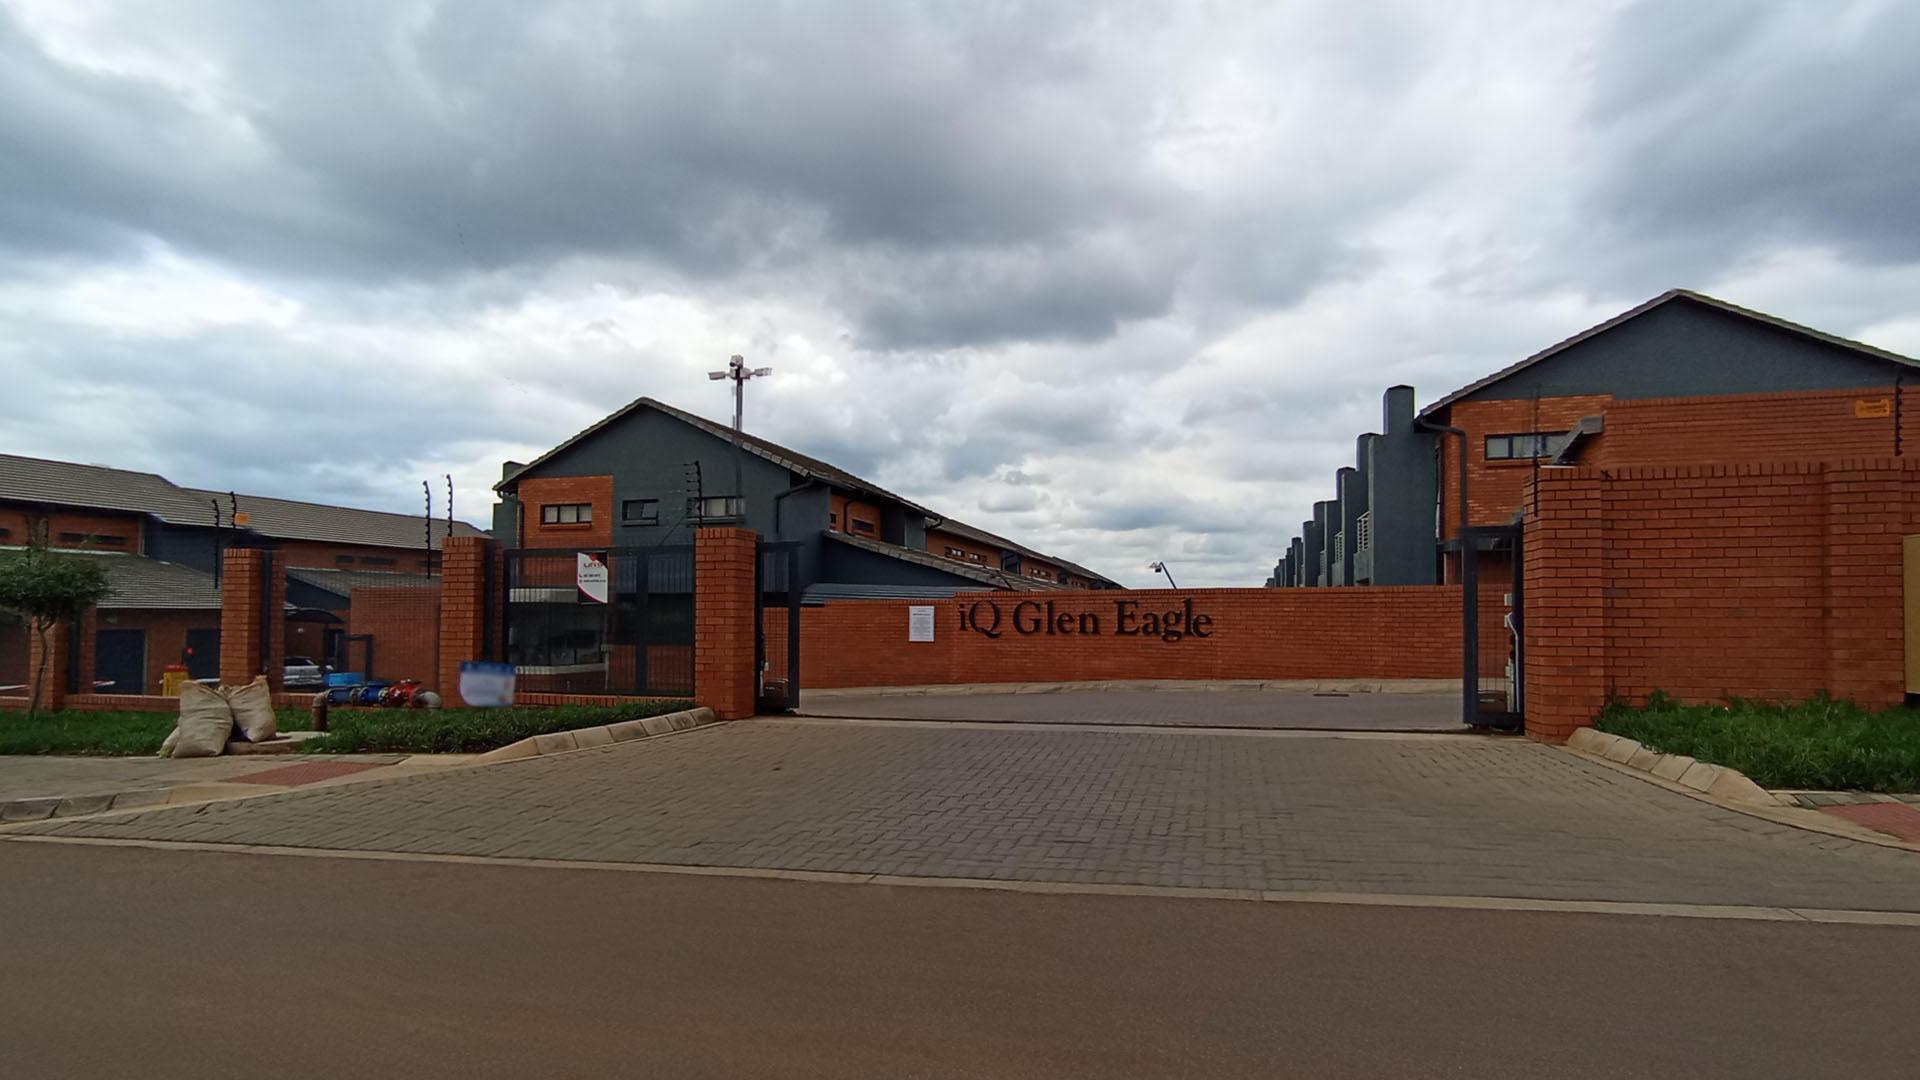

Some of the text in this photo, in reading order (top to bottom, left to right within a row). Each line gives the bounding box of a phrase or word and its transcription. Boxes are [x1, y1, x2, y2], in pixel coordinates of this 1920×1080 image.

[959, 600, 1002, 638] iQ
[1012, 600, 1100, 635] Glen
[1114, 598, 1214, 642] Eagle
